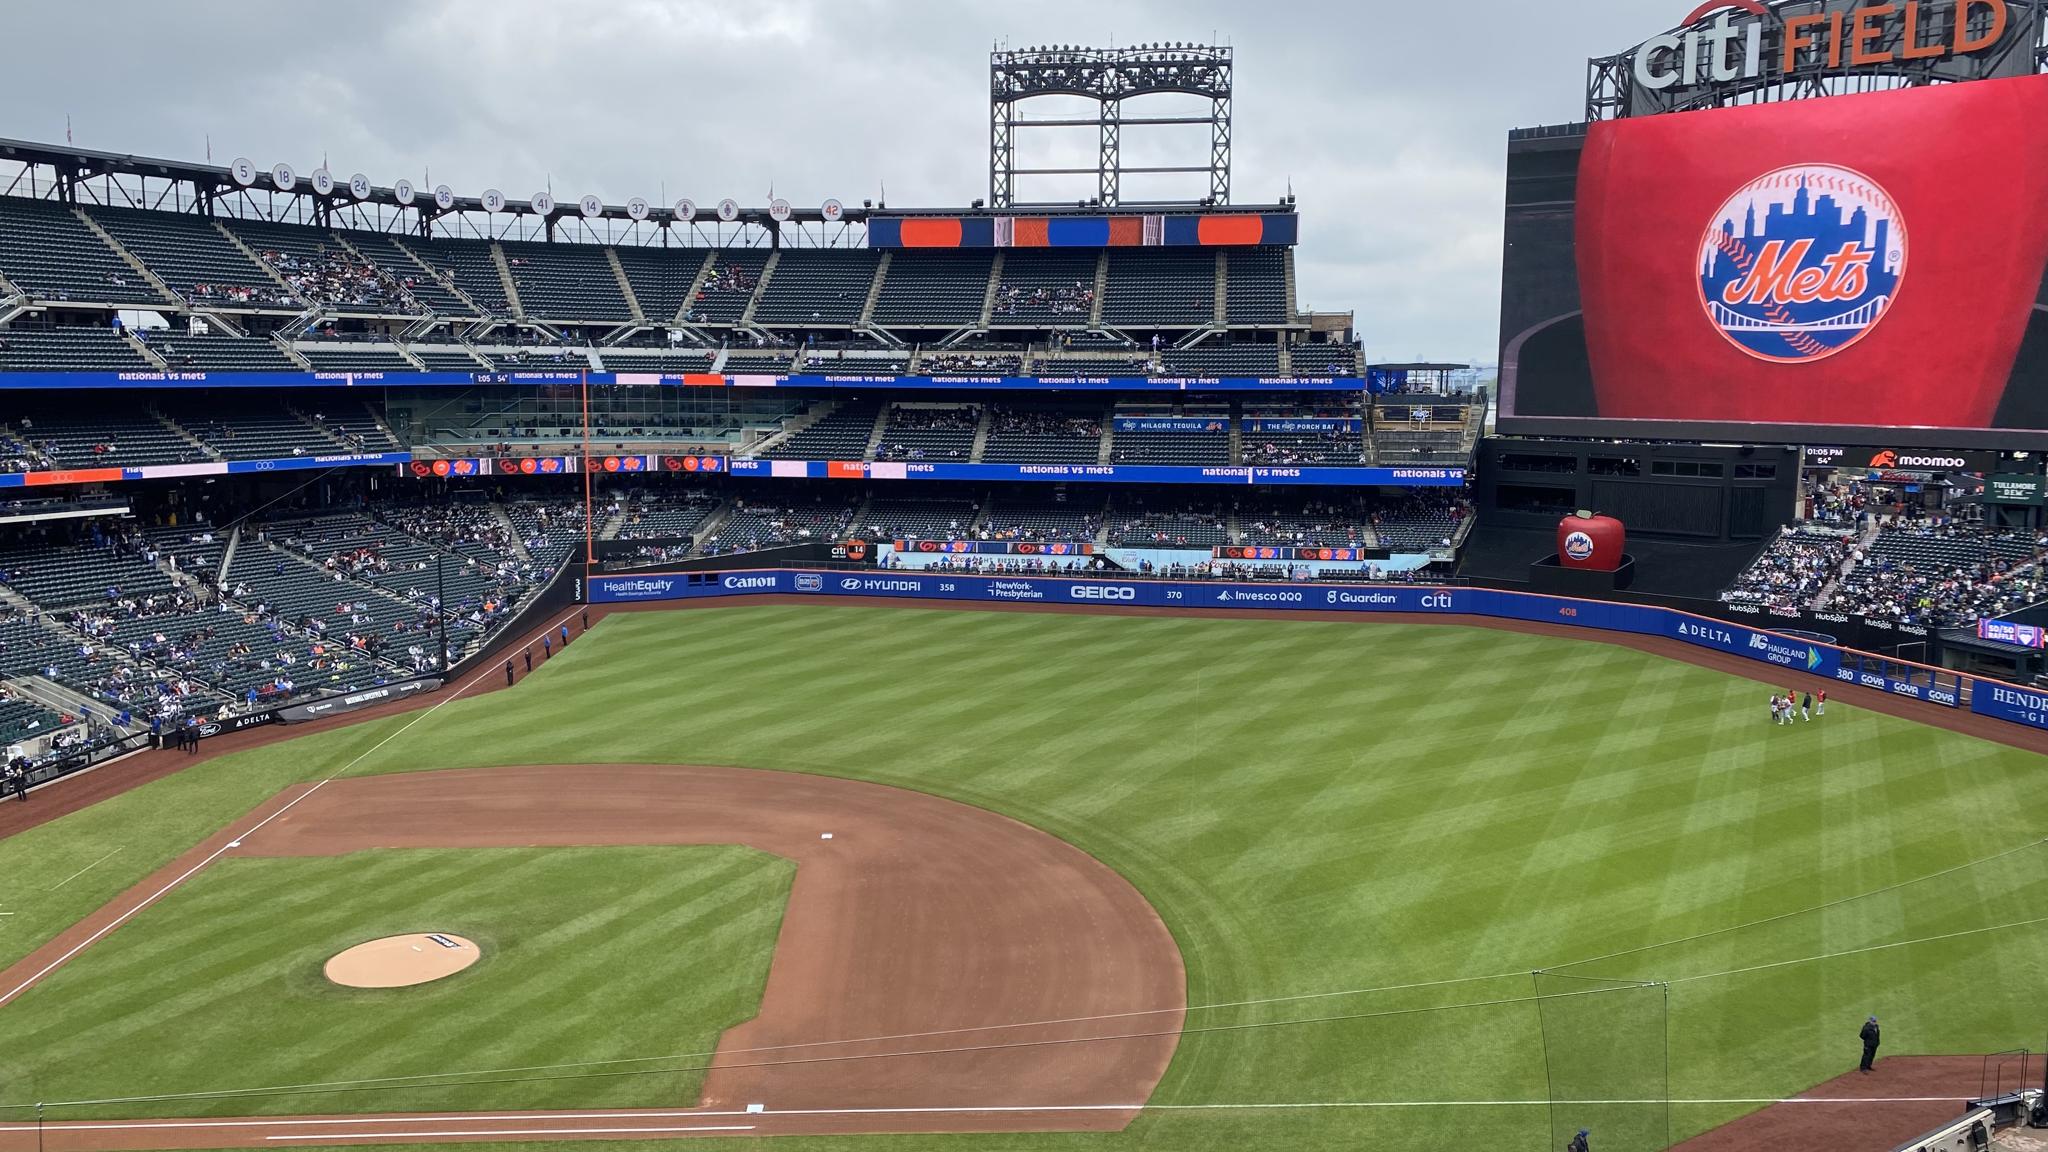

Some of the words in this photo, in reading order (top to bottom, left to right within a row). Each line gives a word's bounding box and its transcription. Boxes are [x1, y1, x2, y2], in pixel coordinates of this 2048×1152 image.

[1635, 11, 1762, 89] citi
[1783, 0, 2007, 73] FIELD
[240, 166, 248, 178] 5
[279, 171, 290, 183] 18
[318, 175, 328, 187] 16
[354, 181, 367, 193] 24
[400, 186, 409, 198] 17
[439, 192, 450, 203] 36
[488, 196, 499, 206] 31
[537, 198, 548, 209] 41
[586, 201, 596, 212] 14
[632, 204, 644, 214] 37
[771, 205, 789, 215] SHEA
[825, 205, 838, 216] 42
[1722, 237, 1876, 305] Mets
[118, 372, 166, 381] nationals
[168, 373, 179, 381] vs
[181, 373, 206, 381] mets
[314, 372, 350, 380] nationa
[1807, 448, 1828, 456] 01:05
[732, 461, 758, 470] mets
[1899, 455, 1965, 468] moomoo
[907, 463, 935, 472] mets
[1020, 465, 1069, 473] nationals
[1071, 466, 1084, 474] vs
[1086, 466, 1114, 474] mets
[1203, 468, 1252, 476] national
[1393, 469, 1446, 478] nationals
[1449, 470, 1463, 478] vs
[1992, 482, 2037, 490] TULLAMORE
[831, 546, 846, 555] citi
[604, 580, 672, 592] HealthEquity
[724, 576, 776, 589] Canon
[865, 580, 921, 591] HYUNDAI
[939, 583, 955, 592] 358
[996, 582, 1032, 591] NewYork-
[996, 589, 1043, 599] Presbyterian
[1070, 585, 1135, 600] GEICO
[1166, 591, 1182, 599] 370
[1235, 590, 1277, 601] Invesco
[1279, 592, 1302, 601] QQQ
[1340, 592, 1397, 604] Guardian
[1421, 594, 1452, 608] citi
[1559, 607, 1577, 617] 408
[1729, 604, 1760, 614] HubSpot
[1815, 613, 1848, 622] HubSpot
[1865, 618, 1892, 629] HubSpot
[1988, 624, 2015, 634] 50/50
[1691, 624, 1731, 644] DELTA
[1899, 625, 1928, 636] HubSpot
[1988, 632, 2015, 641] RAFFLE
[1768, 644, 1806, 660] HAUGLAND
[1767, 652, 1791, 664] GROUP
[1837, 669, 1853, 681] 380
[1861, 674, 1885, 687] GOYA
[1894, 682, 1918, 695] GOYA
[1928, 689, 1954, 703] GOYA
[244, 713, 270, 725] DELTA
